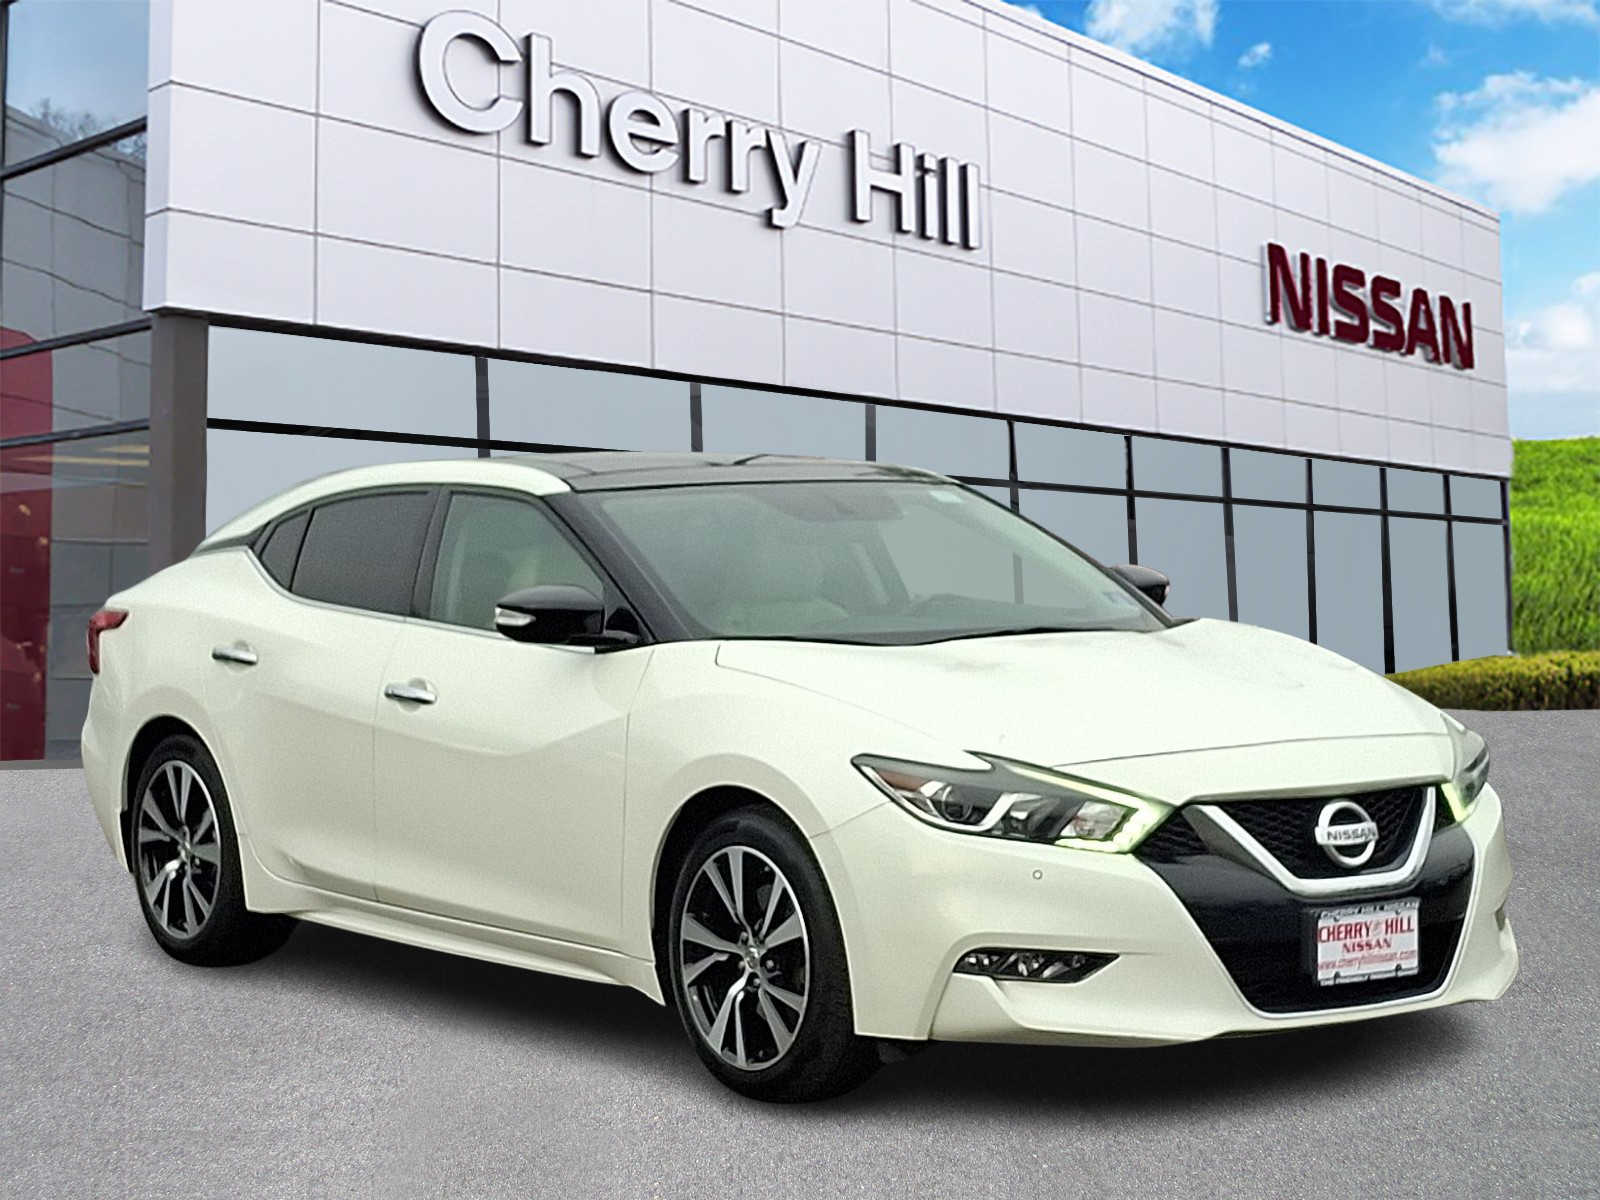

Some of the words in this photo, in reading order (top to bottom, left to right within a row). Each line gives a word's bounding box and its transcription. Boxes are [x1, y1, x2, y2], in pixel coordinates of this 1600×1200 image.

[415, 10, 820, 228] Cherry
[849, 129, 981, 250] Hill
[1264, 242, 1475, 370] NISSAN
[1328, 828, 1376, 841] NISSAN
[1318, 921, 1372, 943] CHERRY
[1384, 916, 1415, 935] HILL
[1342, 937, 1391, 953] NISSAN
